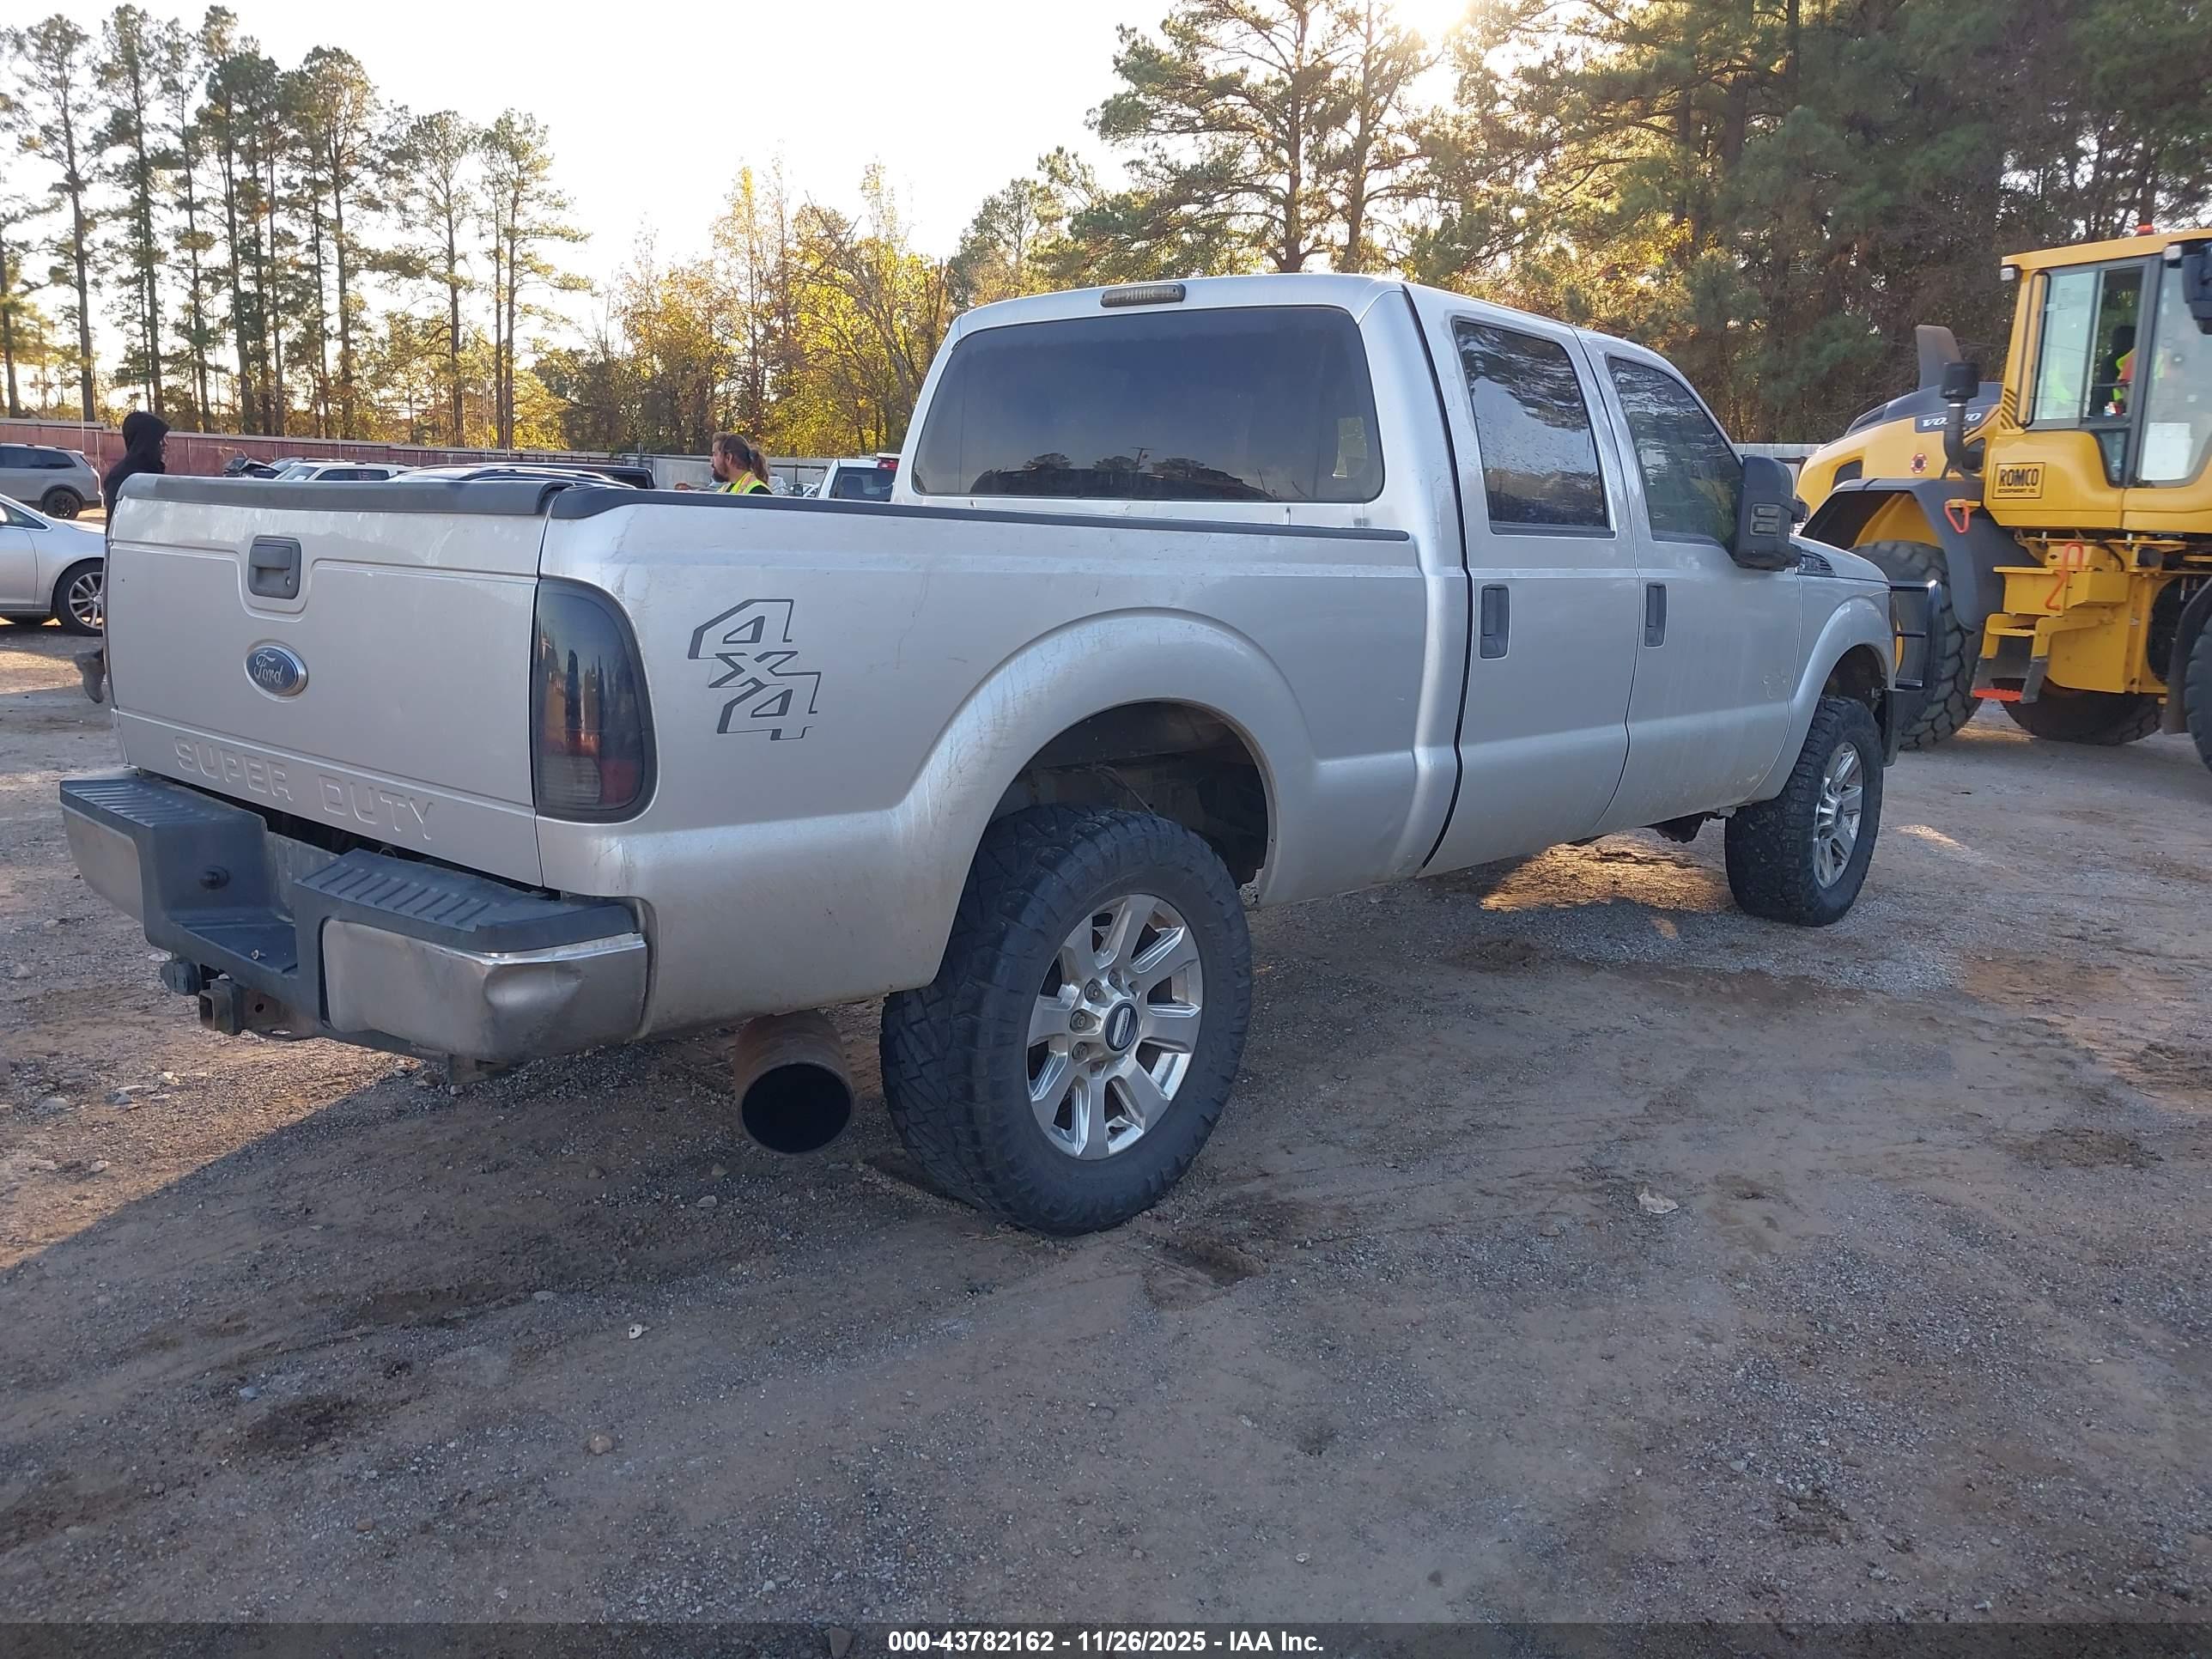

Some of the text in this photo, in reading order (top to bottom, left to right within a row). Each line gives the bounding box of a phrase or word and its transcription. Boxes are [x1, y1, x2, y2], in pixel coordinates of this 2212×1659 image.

[1923, 412, 1982, 427] VOO
[1999, 468, 2039, 486] ROMCO
[253, 653, 283, 684] Ford
[174, 735, 434, 840] SUPER DUTY
